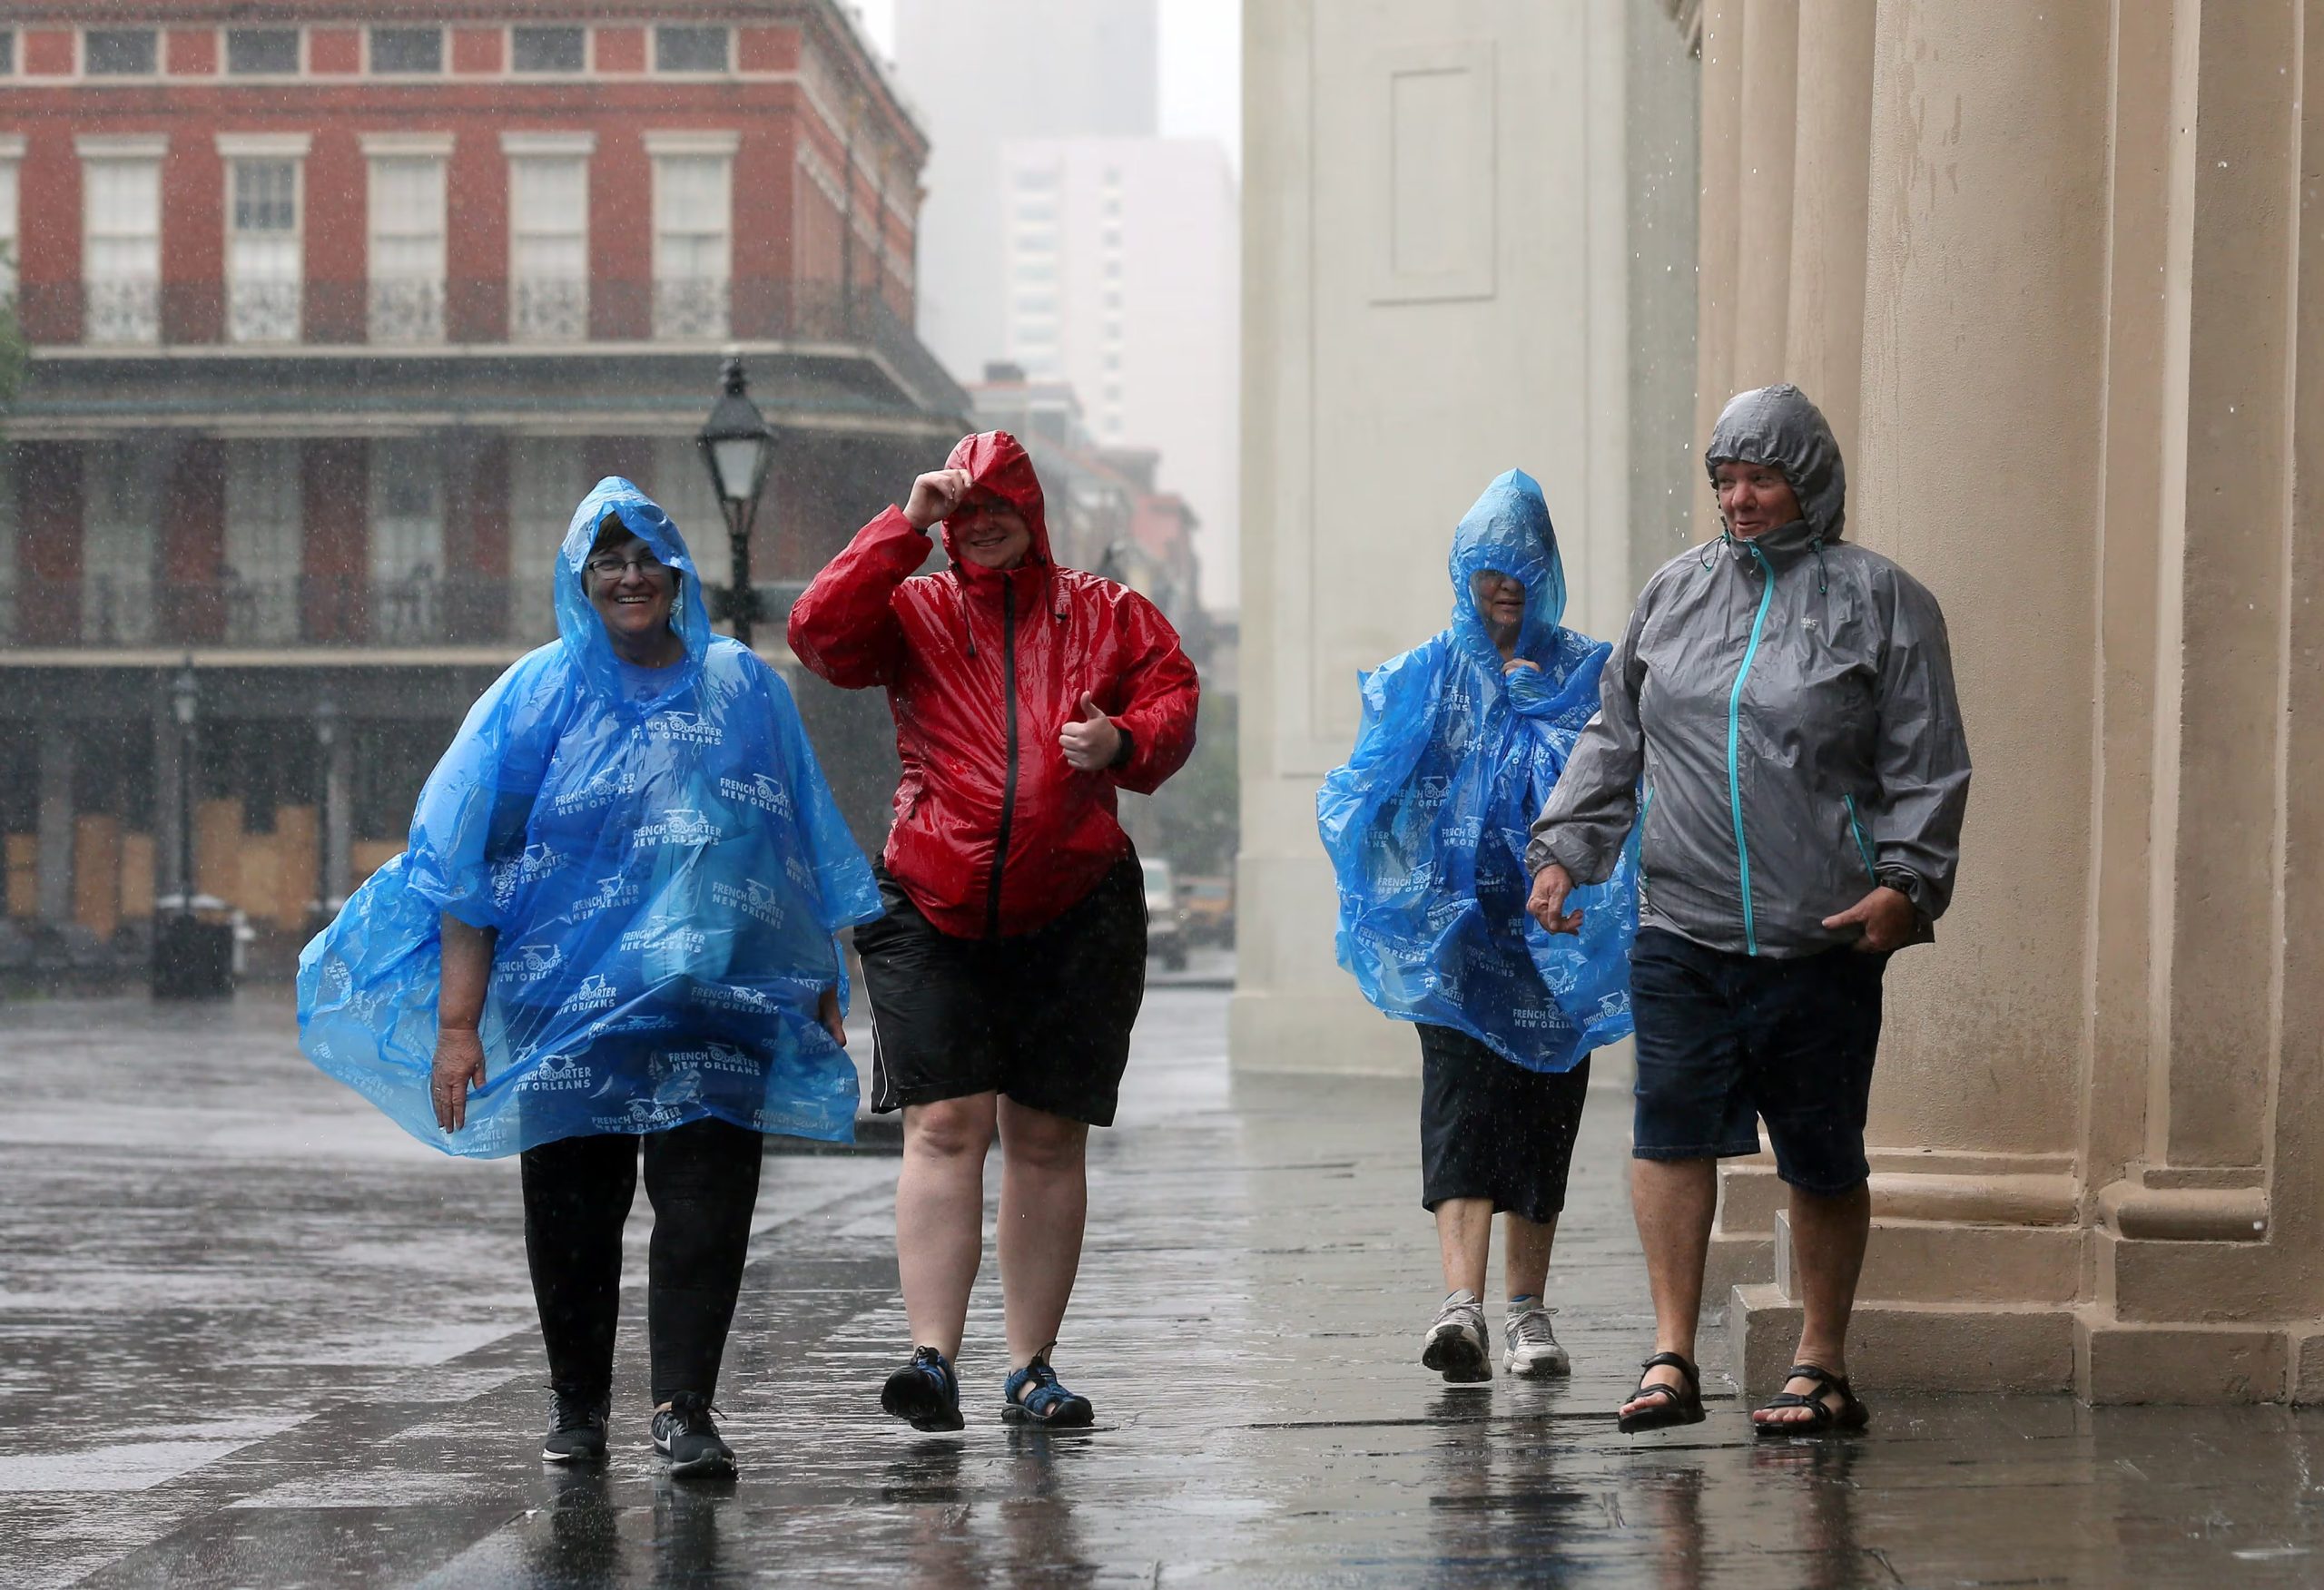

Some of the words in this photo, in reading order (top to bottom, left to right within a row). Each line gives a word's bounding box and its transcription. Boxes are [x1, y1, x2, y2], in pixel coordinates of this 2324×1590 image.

[1554, 706, 1581, 727] RENCH
[663, 731, 721, 746] ORLEANS
[720, 777, 755, 796] FRENCH
[555, 788, 592, 807] FRENCH
[721, 788, 745, 802] NEW
[557, 802, 584, 817] NEW
[632, 836, 656, 849] NEW
[1377, 877, 1412, 887] FRENCH
[712, 881, 747, 901] FRENCH
[712, 894, 737, 908] NEW
[742, 903, 782, 930] ORLEANS
[1508, 918, 1524, 928] FRE
[622, 928, 651, 943] FRENCH
[1511, 928, 1524, 936] NE
[620, 941, 641, 952] NEW
[1384, 947, 1427, 962] ORLEAN
[691, 986, 732, 1000] FRENCH
[723, 1002, 779, 1015] ORLEANS
[1512, 1008, 1546, 1019] FRENCH
[1514, 1018, 1536, 1028] NEW
[1583, 1011, 1606, 1027] FRENCH
[668, 1052, 708, 1063] FRENCH
[538, 1066, 592, 1081] QUARTER
[672, 1061, 698, 1073] NEW
[704, 1061, 761, 1076] ORLEANS
[532, 1079, 591, 1091] ORLEANS
[591, 1115, 631, 1125] FRENCH
